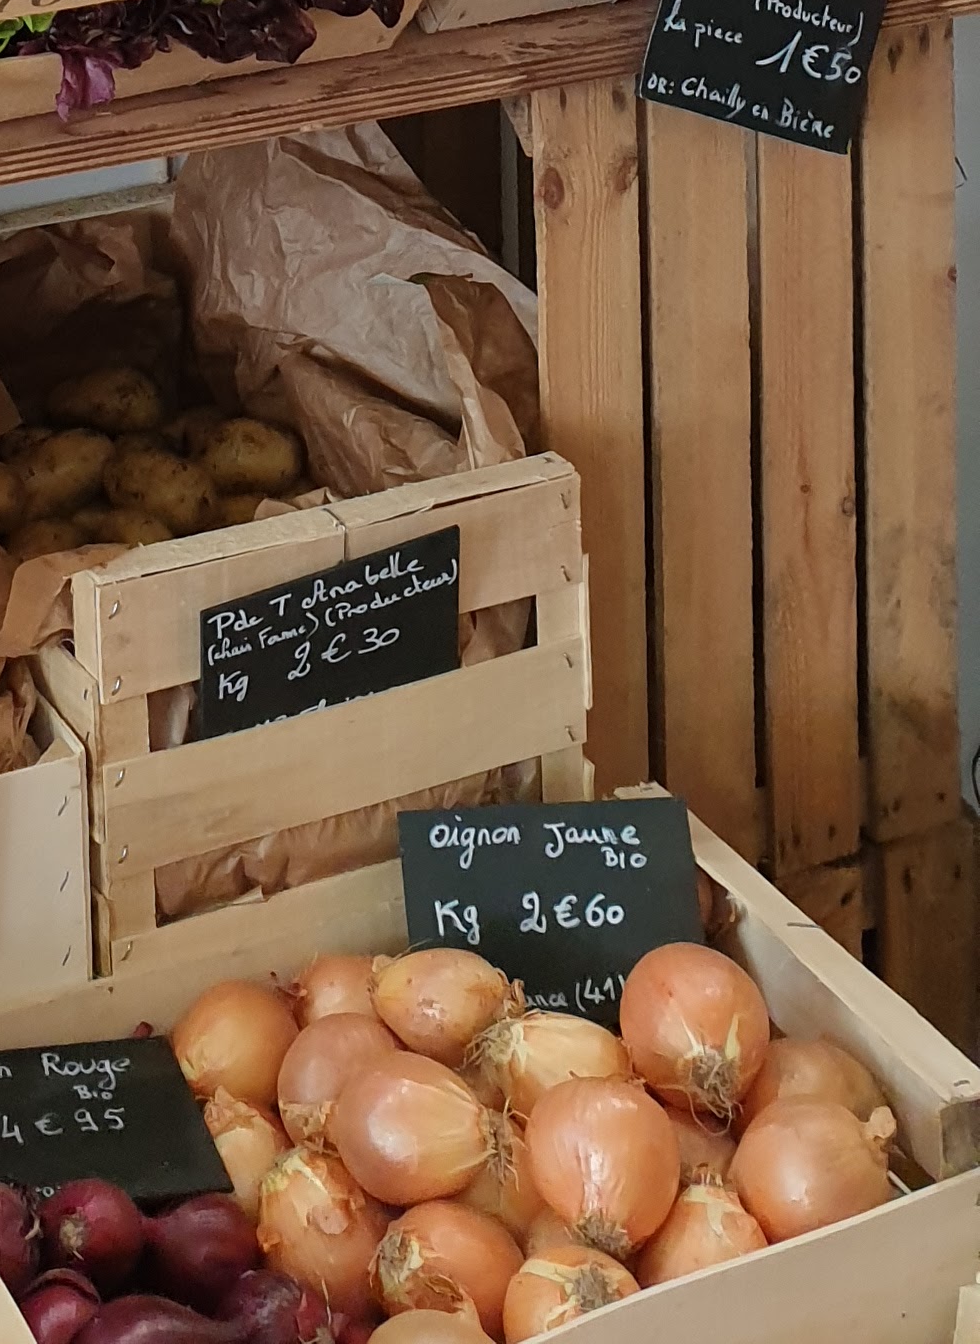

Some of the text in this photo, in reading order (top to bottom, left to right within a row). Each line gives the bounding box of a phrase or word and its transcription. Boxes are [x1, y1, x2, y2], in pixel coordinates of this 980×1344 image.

[680, 76, 746, 119] Chailly
[751, 103, 769, 121] en
[269, 593, 292, 617] T
[543, 821, 641, 859] Jaune
[433, 898, 481, 946] Kg
[40, 1052, 132, 1091] Rouge
